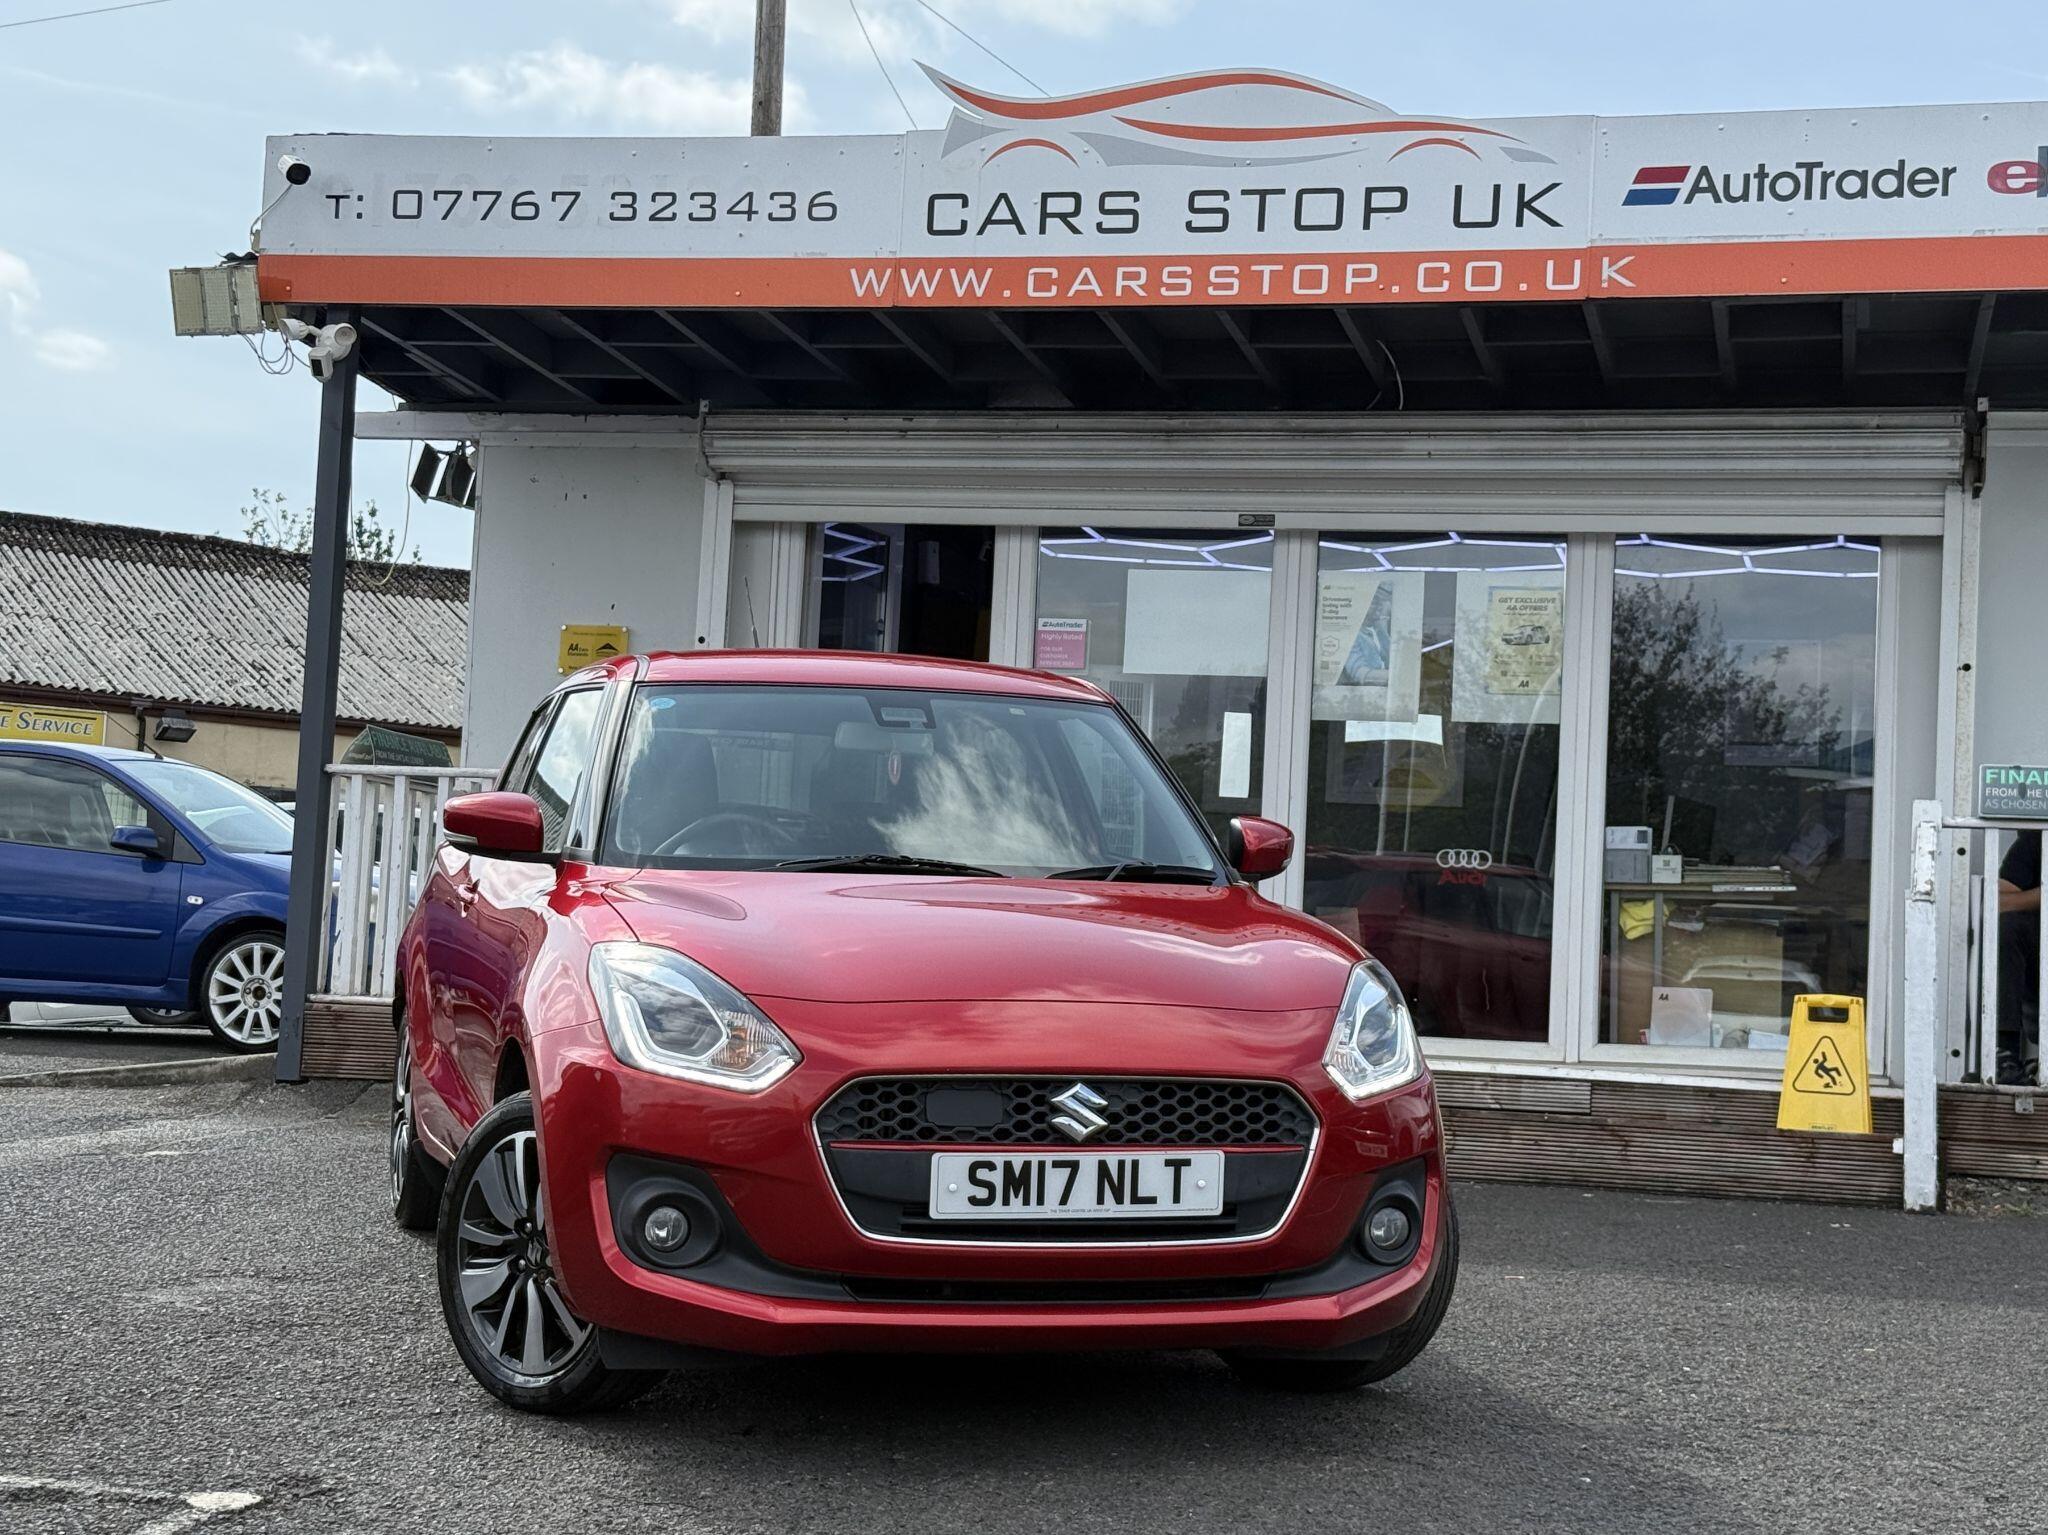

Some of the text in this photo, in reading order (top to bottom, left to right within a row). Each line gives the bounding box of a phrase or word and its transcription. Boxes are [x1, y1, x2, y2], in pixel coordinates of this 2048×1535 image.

[1683, 159, 1957, 204] AutoTrader
[392, 189, 581, 222] 07767
[609, 190, 838, 222] 323436
[926, 182, 1564, 237] CARS STOP UK
[16, 711, 94, 736] SERVICE
[1985, 769, 2048, 786] FINA
[1985, 787, 2017, 798] FROM
[1985, 798, 2047, 810] AS CHOSEN
[967, 1158, 1192, 1207] SM17 NLT
